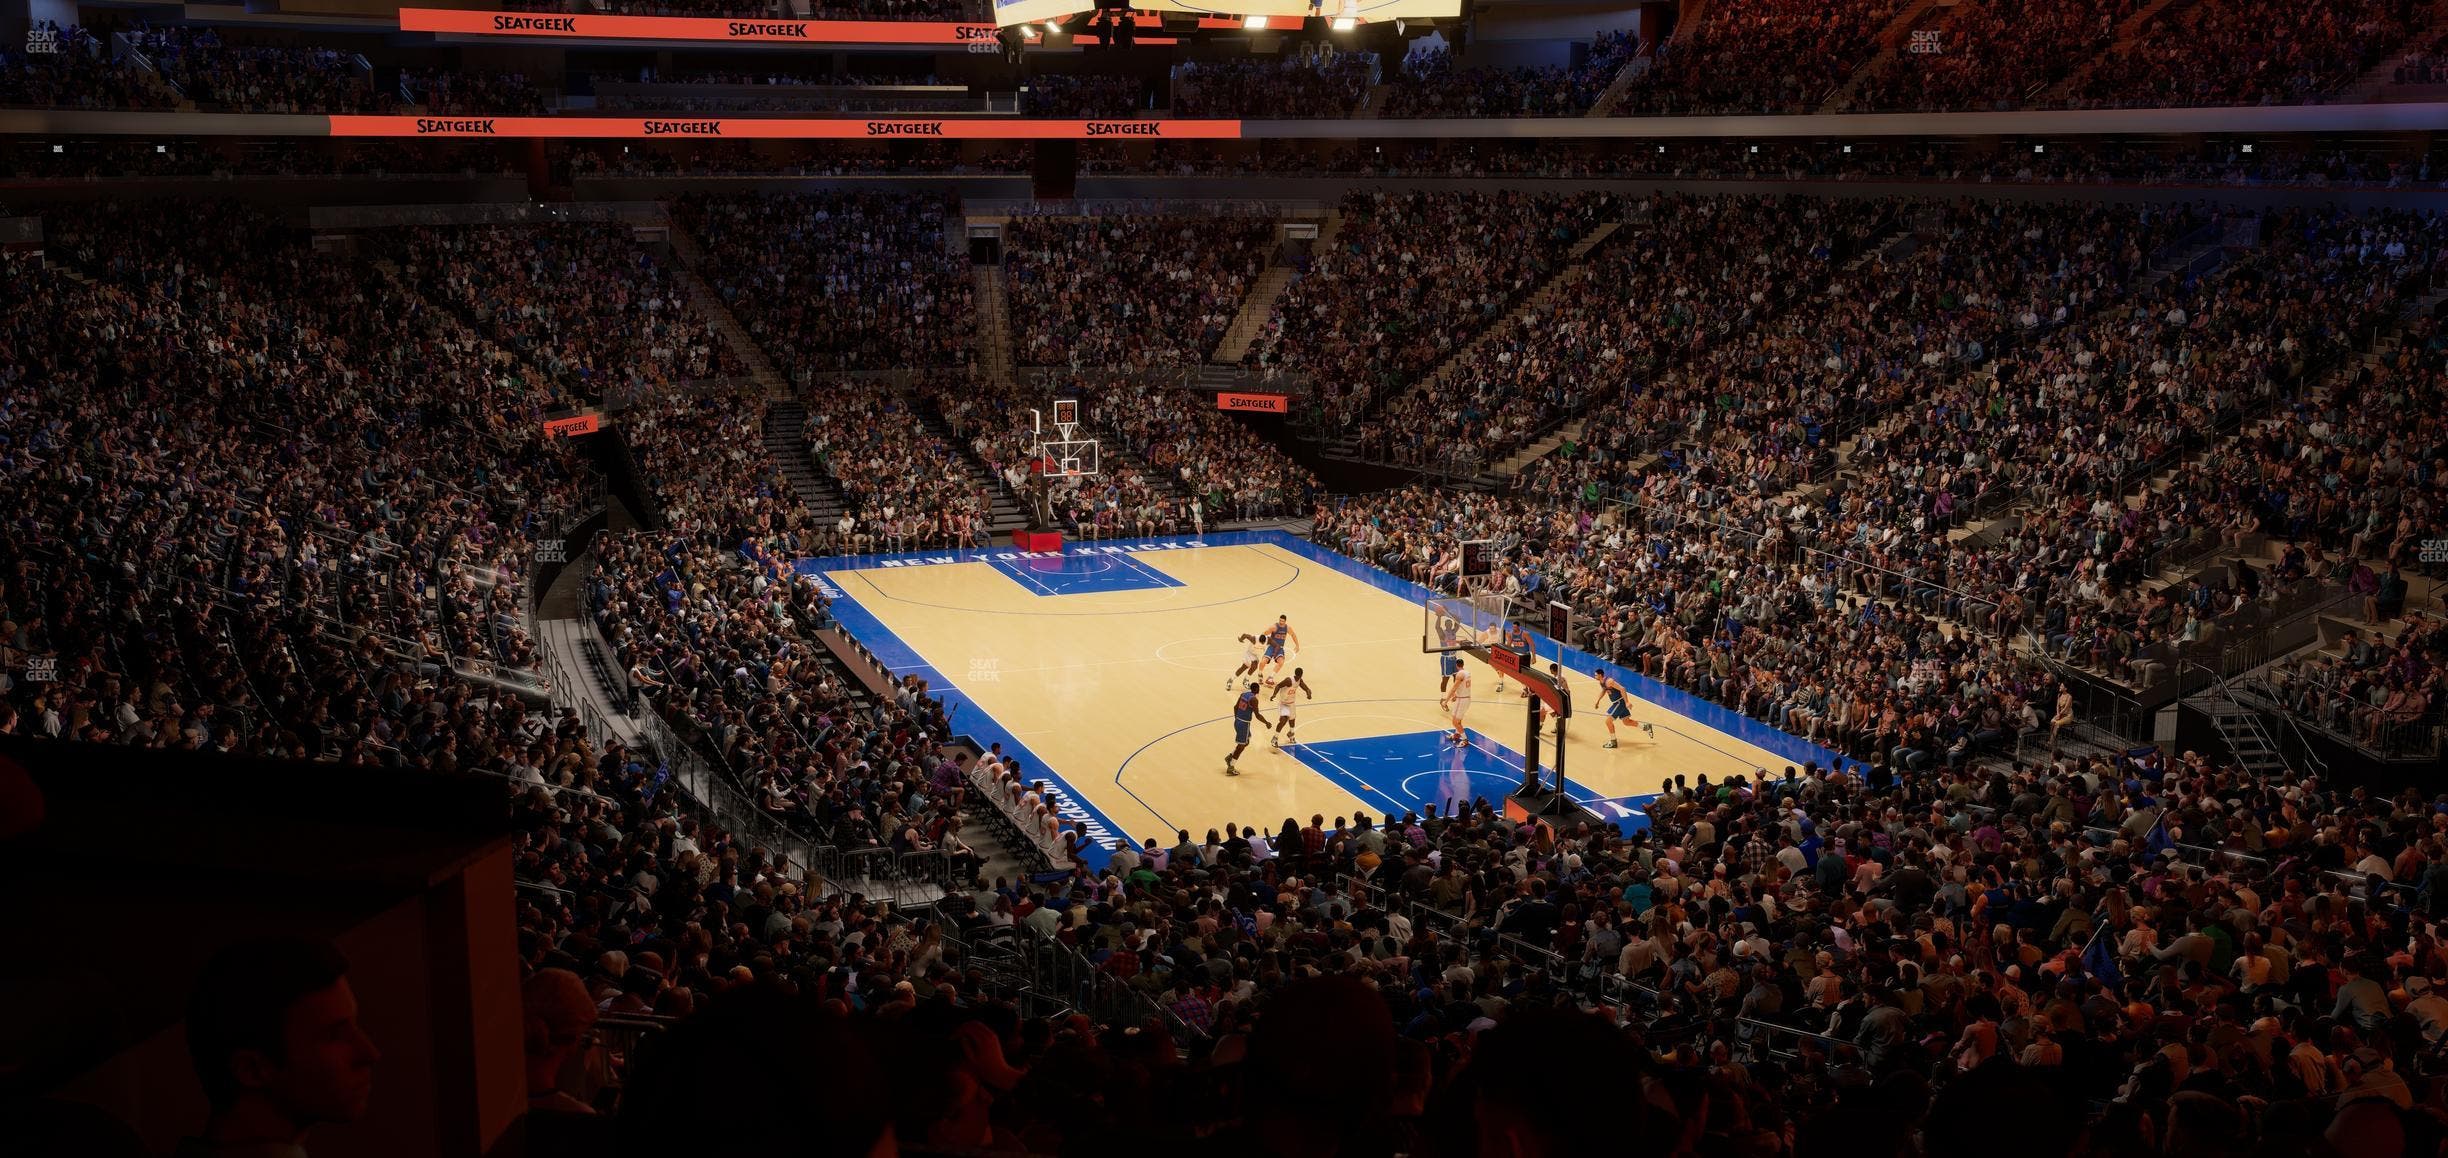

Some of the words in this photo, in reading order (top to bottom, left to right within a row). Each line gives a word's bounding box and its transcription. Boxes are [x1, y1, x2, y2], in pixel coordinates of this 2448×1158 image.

[494, 15, 576, 32] SEATGEEK
[729, 22, 808, 38] SEATGEEK
[417, 119, 495, 134] SEATGEEK
[644, 120, 722, 135] SEATGEEK
[867, 121, 943, 136] SEATGEEK
[1086, 122, 1160, 136] SEATGEEK
[1230, 397, 1276, 410] SEATGEEK
[880, 556, 955, 568] NEW
[1074, 540, 1208, 555] KNICKS
[1493, 648, 1516, 668] SEATGEEK
